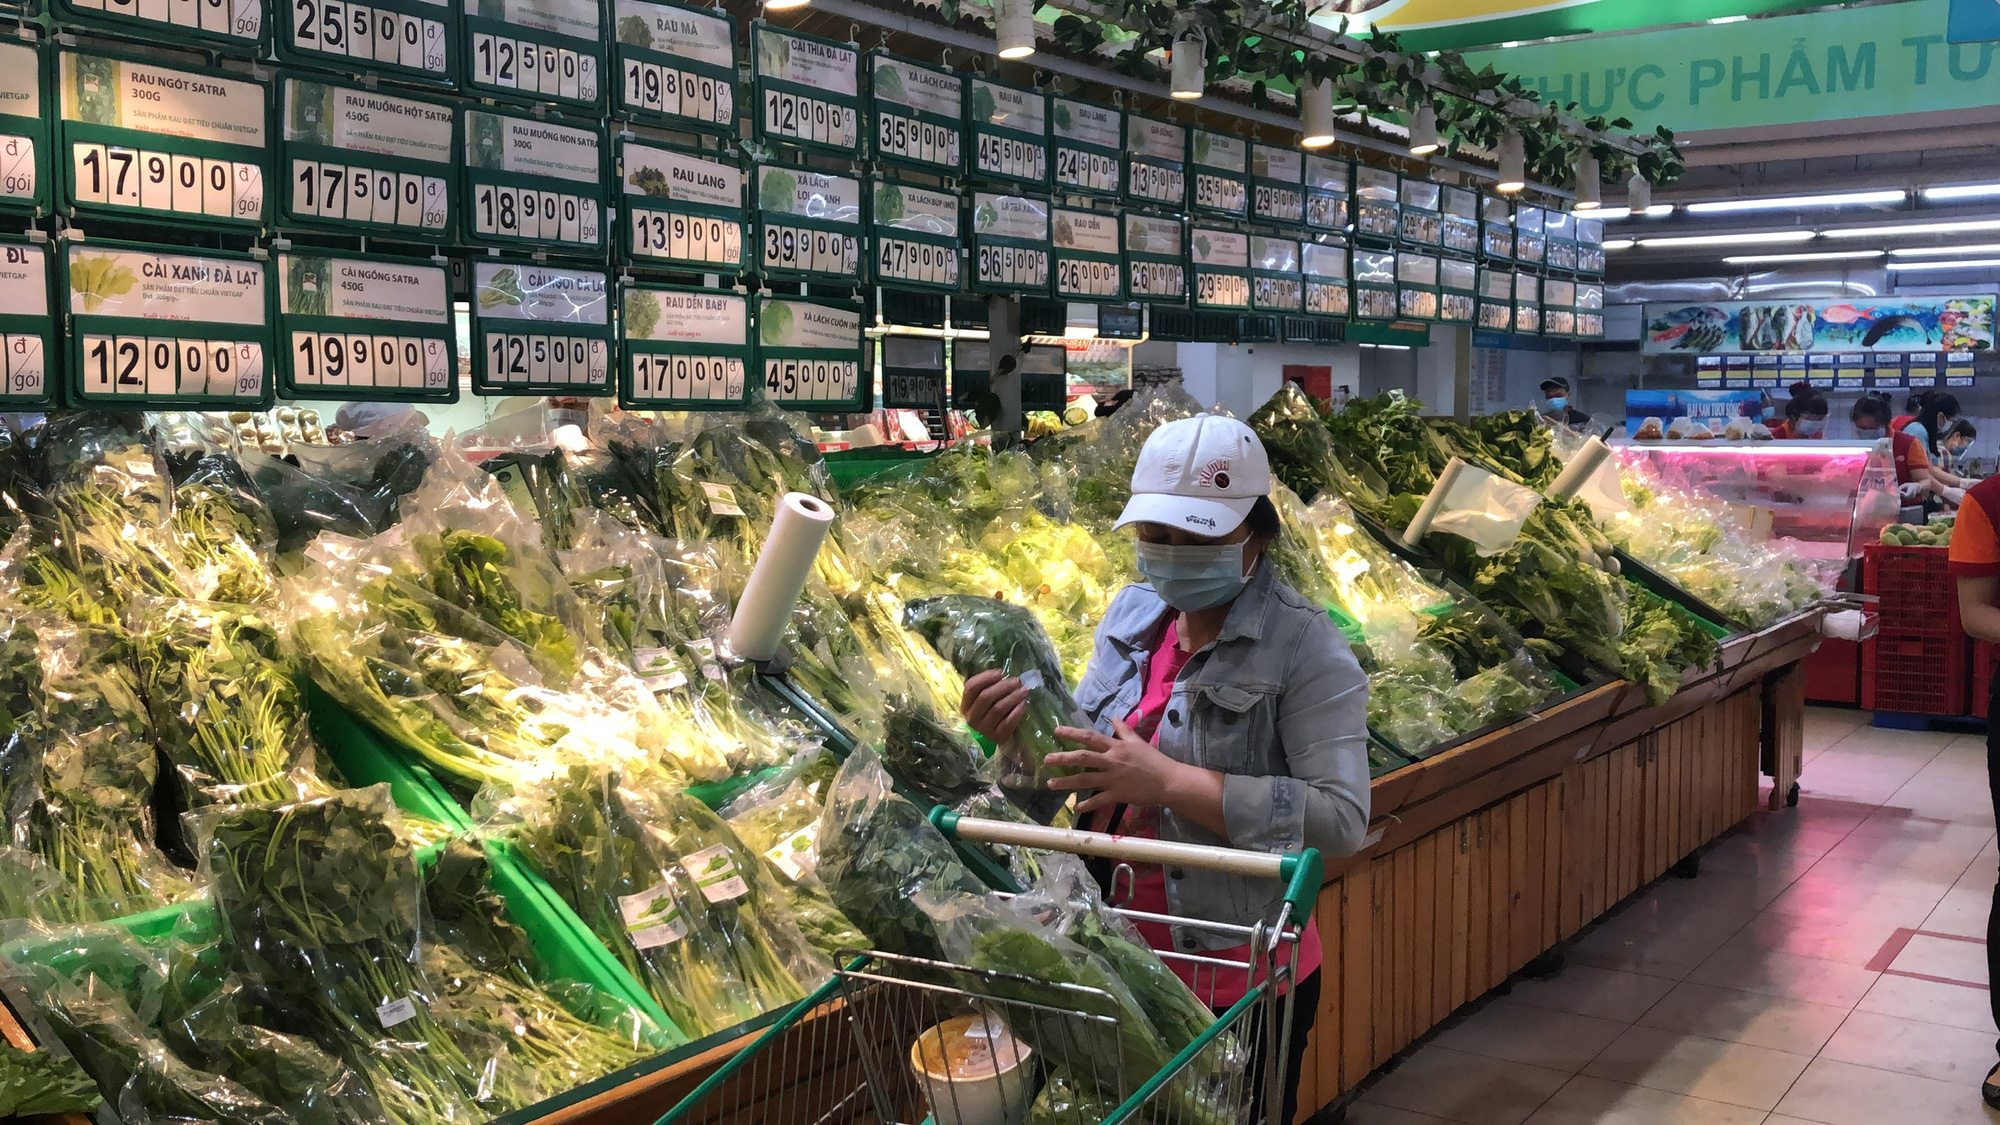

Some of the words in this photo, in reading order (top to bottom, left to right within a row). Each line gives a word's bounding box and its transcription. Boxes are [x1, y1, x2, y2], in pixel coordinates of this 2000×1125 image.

[657, 18, 678, 33] RAU
[681, 21, 698, 36] MÁ
[1689, 37, 1876, 106] PHẨM
[131, 72, 154, 84] RAU
[158, 77, 190, 90] NGÓT
[192, 82, 226, 97] SATRA
[132, 88, 160, 102] 300G
[345, 111, 370, 122] 450G
[346, 96, 365, 107] RAU
[425, 110, 453, 123] SATRA
[512, 126, 528, 136] RAU
[560, 134, 576, 145] NON
[513, 139, 532, 150] 300G
[673, 167, 694, 183] RAU
[697, 174, 726, 190] LANG
[810, 176, 829, 189] LÁCH
[142, 258, 168, 278] CẢI
[172, 264, 210, 282] XANH
[214, 265, 233, 284] ĐÀ
[237, 270, 258, 290] LẠT
[341, 267, 356, 277] CẢI
[392, 274, 420, 286] SATRA
[528, 270, 547, 287] CẢI
[341, 281, 364, 292] 450G
[666, 296, 684, 308] RAU
[706, 300, 728, 311] BABY
[1200, 459, 1230, 487] PUMA
